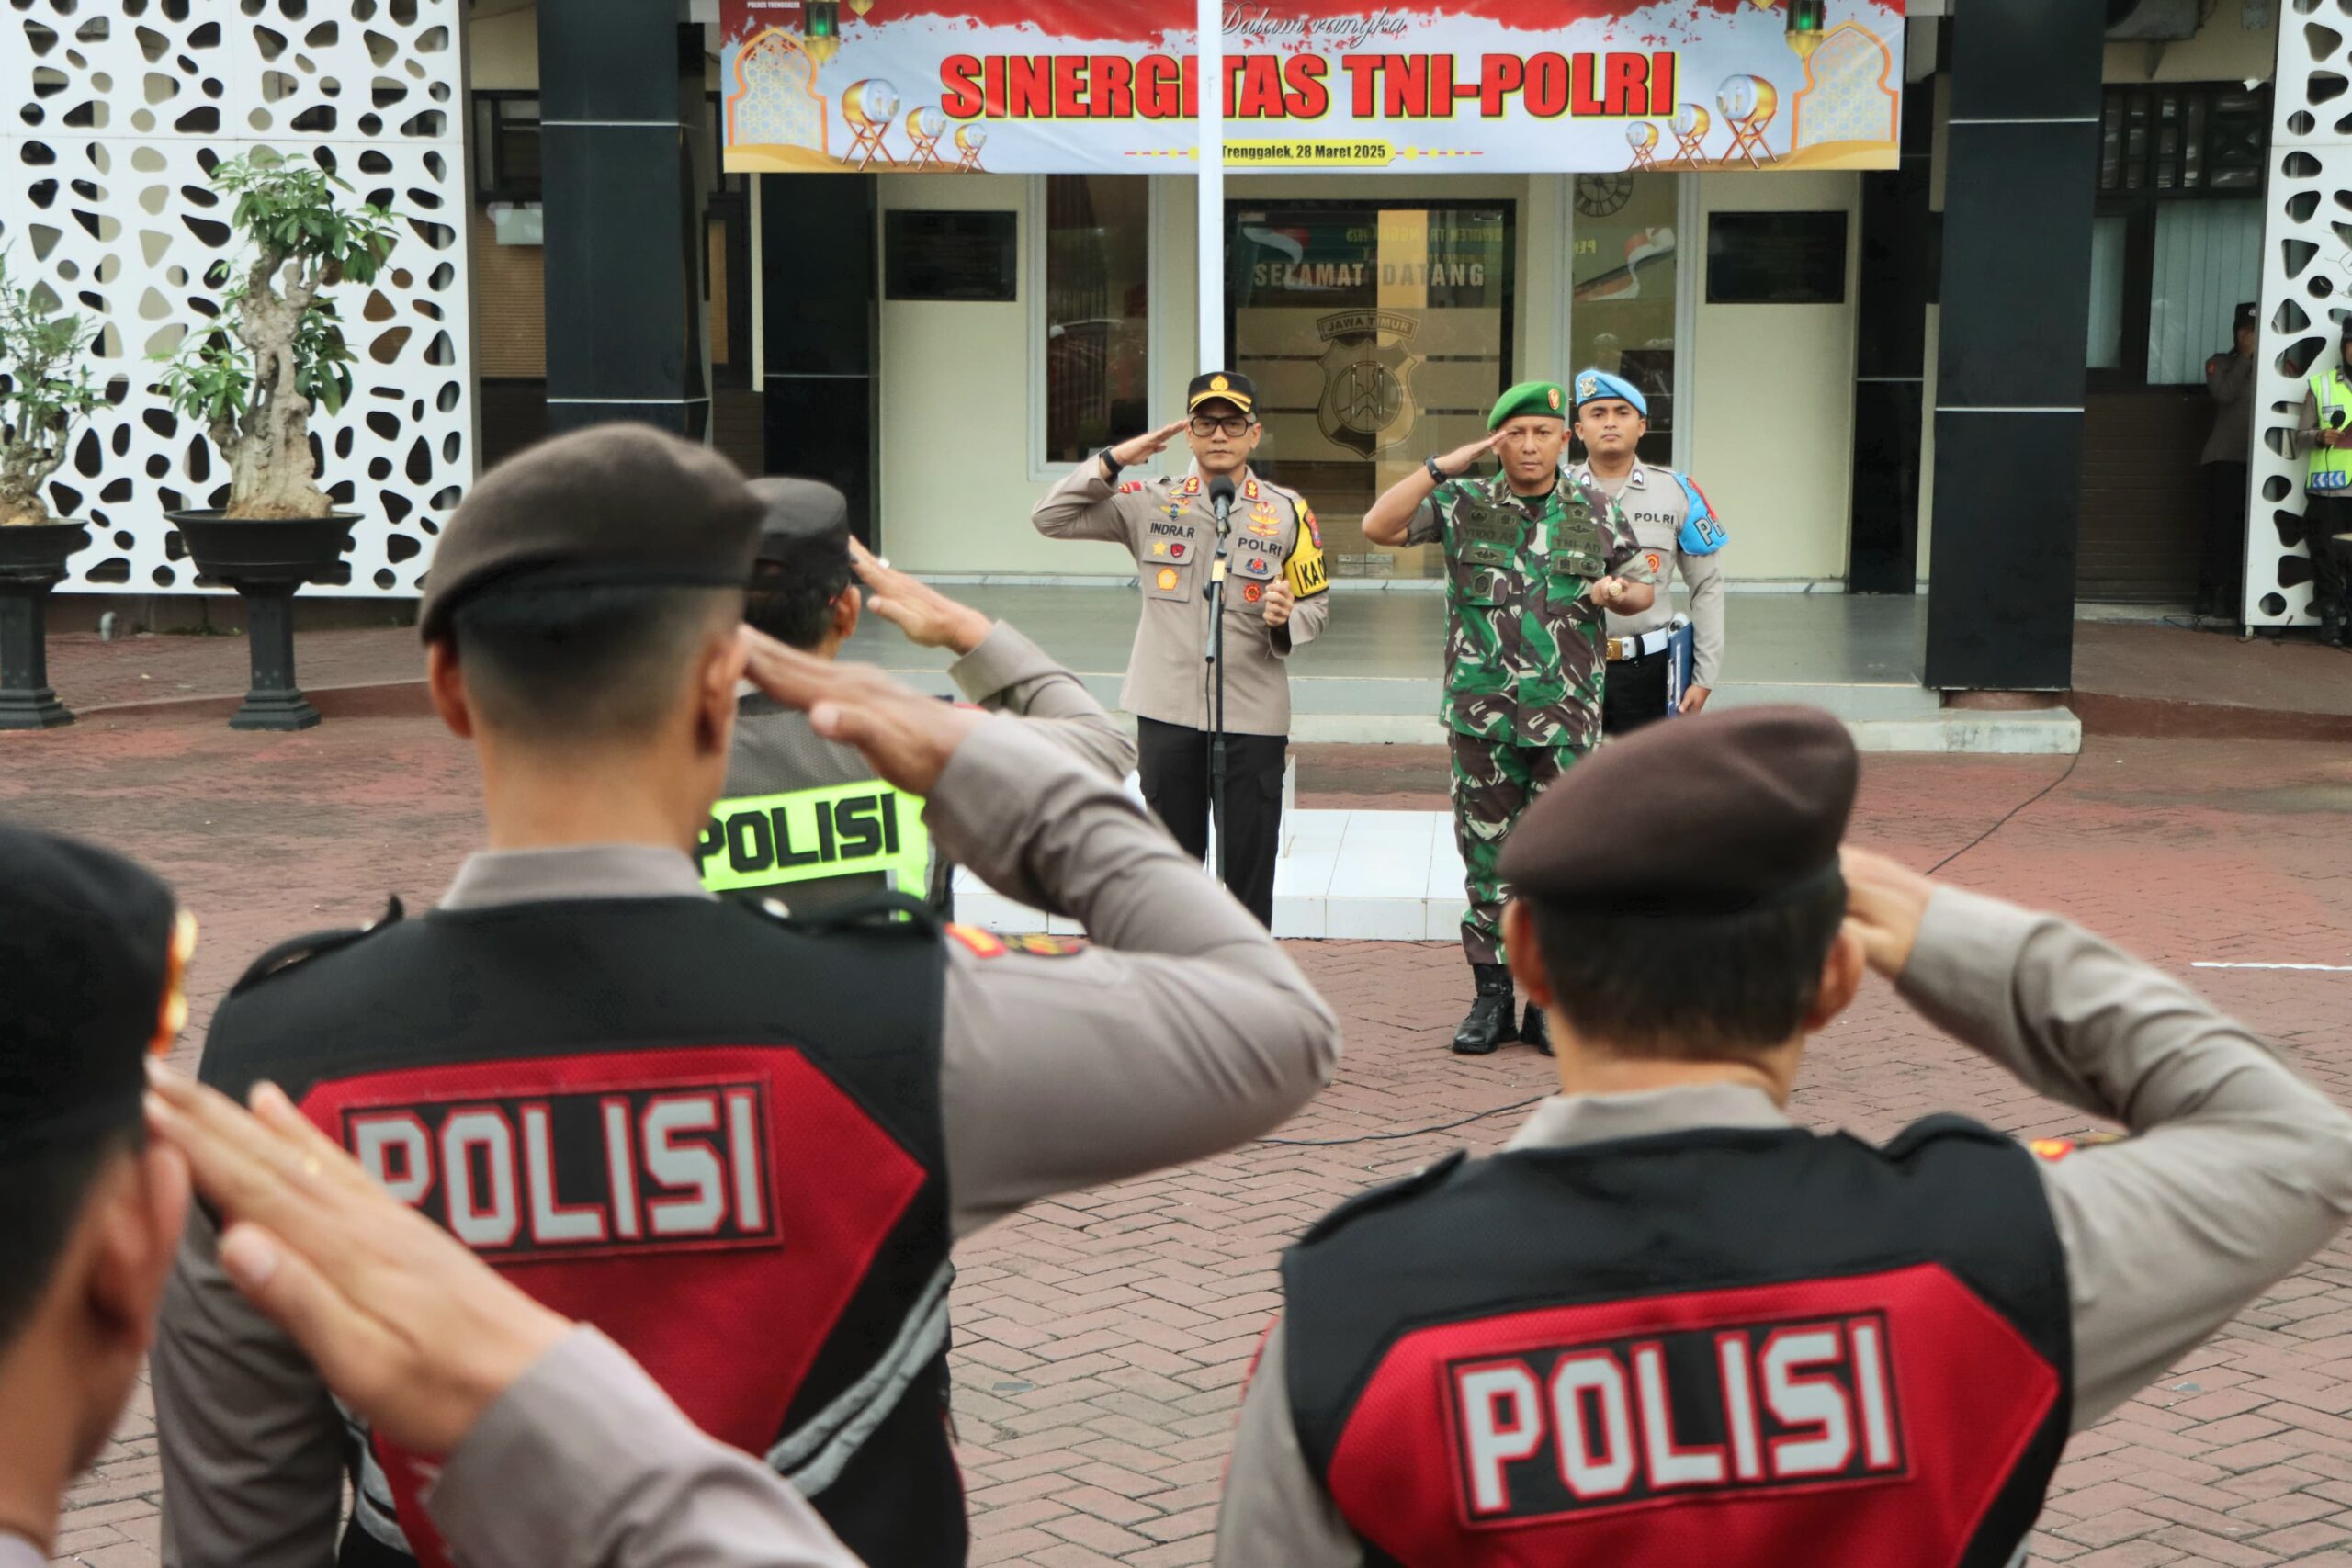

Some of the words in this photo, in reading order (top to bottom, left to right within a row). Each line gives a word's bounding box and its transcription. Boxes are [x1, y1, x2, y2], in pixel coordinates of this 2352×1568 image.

[1222, 1, 1306, 35] Dalam
[1311, 7, 1408, 49] rangka
[1342, 51, 1677, 119] TNI-POLRI
[1222, 144, 1294, 160] Trenggalek,
[1296, 144, 1312, 159] 28
[1315, 144, 1351, 159] Maret
[1354, 144, 1385, 159] 2025
[1253, 263, 1363, 287] SELAMAT
[1382, 263, 1486, 287] DATANG
[1329, 317, 1363, 331] JAWA
[1150, 522, 1194, 539] INDRA.R
[1634, 512, 1675, 525] POLRI
[1238, 537, 1282, 557] POLRI
[693, 791, 901, 879] POLISI
[351, 1092, 768, 1249] POLISI
[1457, 1321, 1898, 1516] POLISI
